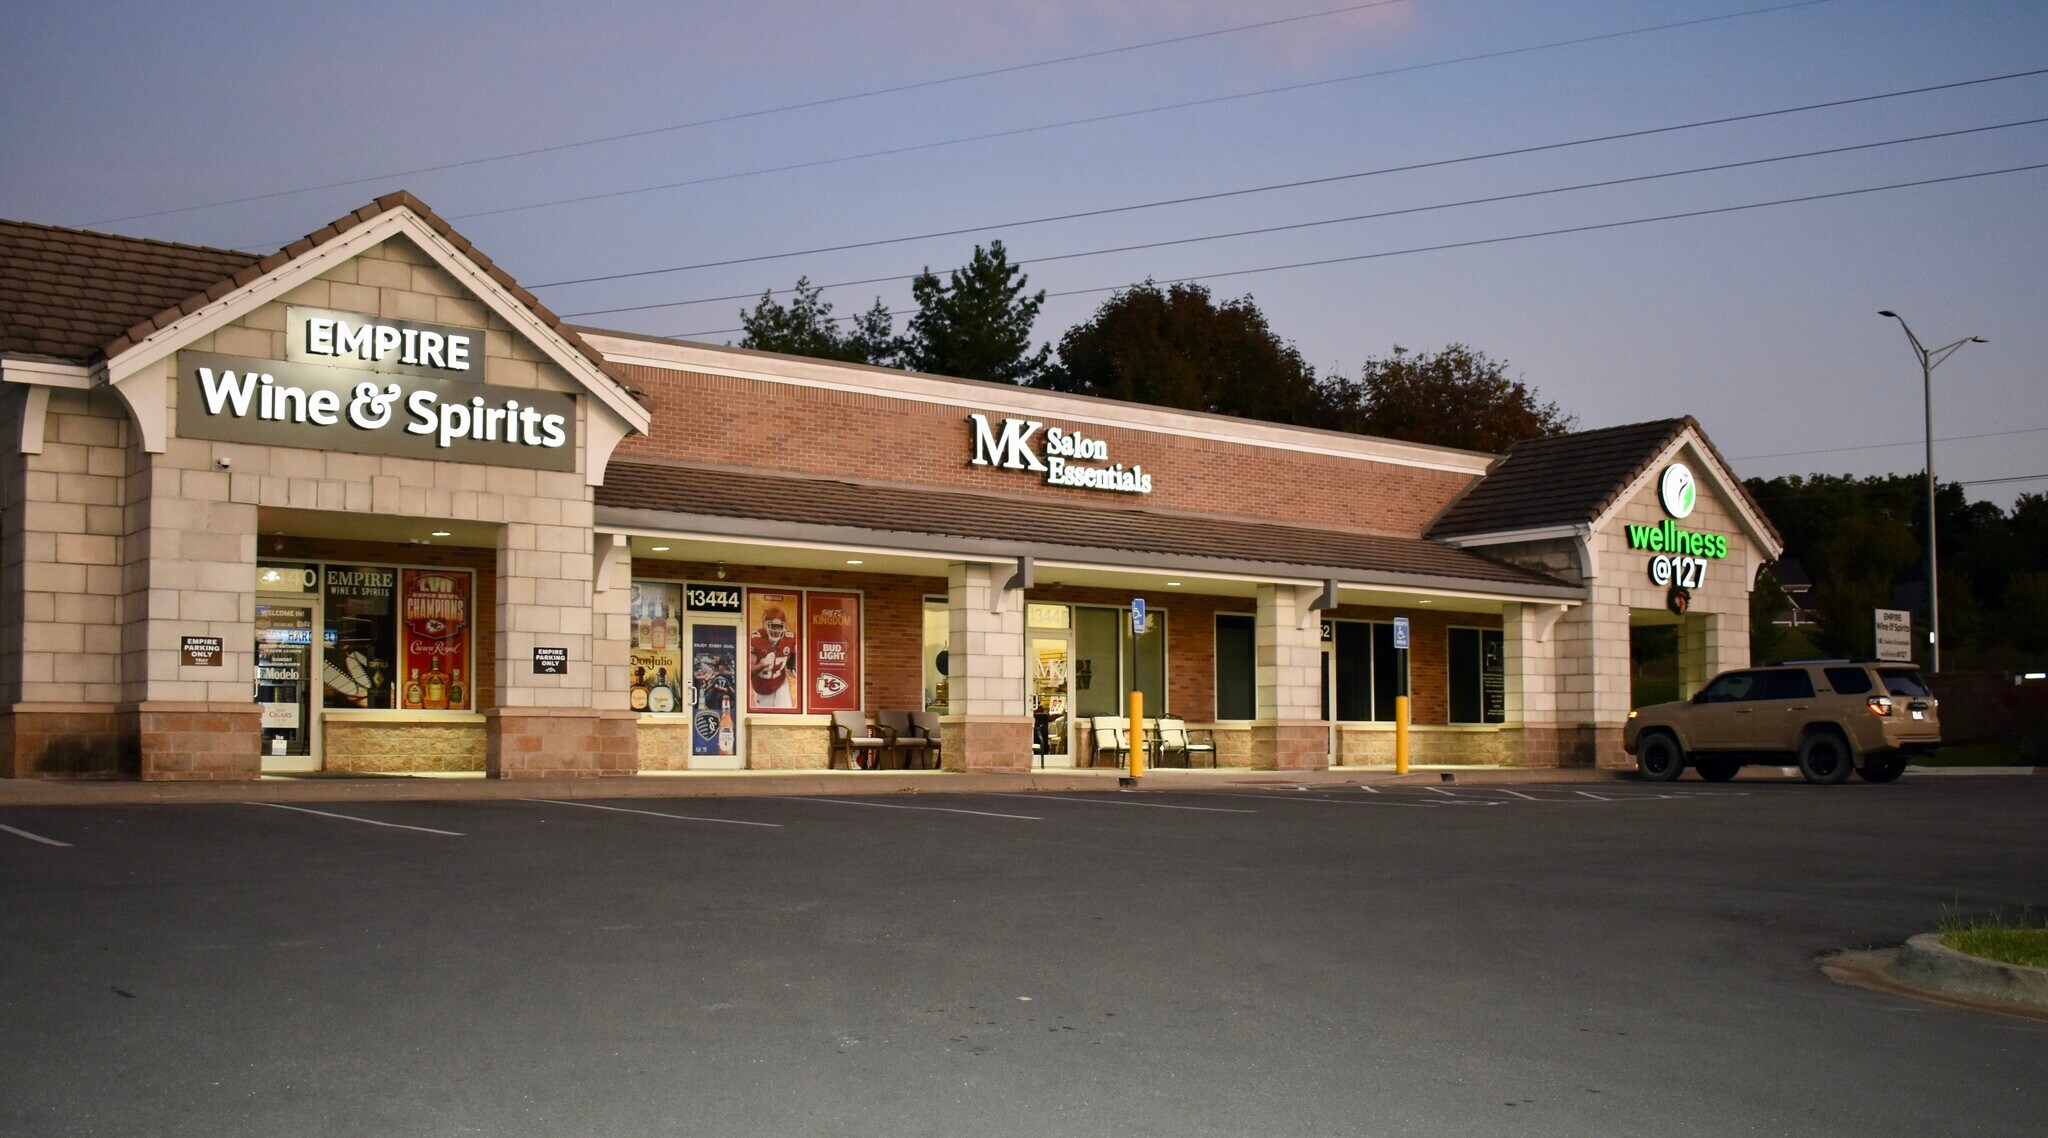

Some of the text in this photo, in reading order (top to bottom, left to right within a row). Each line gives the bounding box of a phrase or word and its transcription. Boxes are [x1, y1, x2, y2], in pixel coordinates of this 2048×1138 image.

[308, 317, 470, 371] EMPIRE
[199, 367, 566, 449] Wine & Spirits
[970, 413, 1048, 472] MK
[1046, 426, 1109, 461] Salon
[1047, 456, 1152, 494] Essentials
[1629, 519, 1728, 559] wellness
[327, 570, 393, 588] EMPIRE
[1652, 554, 1708, 589] @127
[330, 586, 390, 597] WINE & SPIRITS
[687, 590, 740, 608] 13444
[407, 598, 464, 621] CHAMPIONS
[1884, 612, 1902, 621] EMPIRE
[812, 614, 851, 626] KINGDOM
[184, 644, 220, 652] PARKING
[410, 640, 461, 655] Crown Royal
[819, 651, 846, 661] LIGHT
[822, 643, 842, 652] BUD
[264, 667, 299, 680] Modelo
